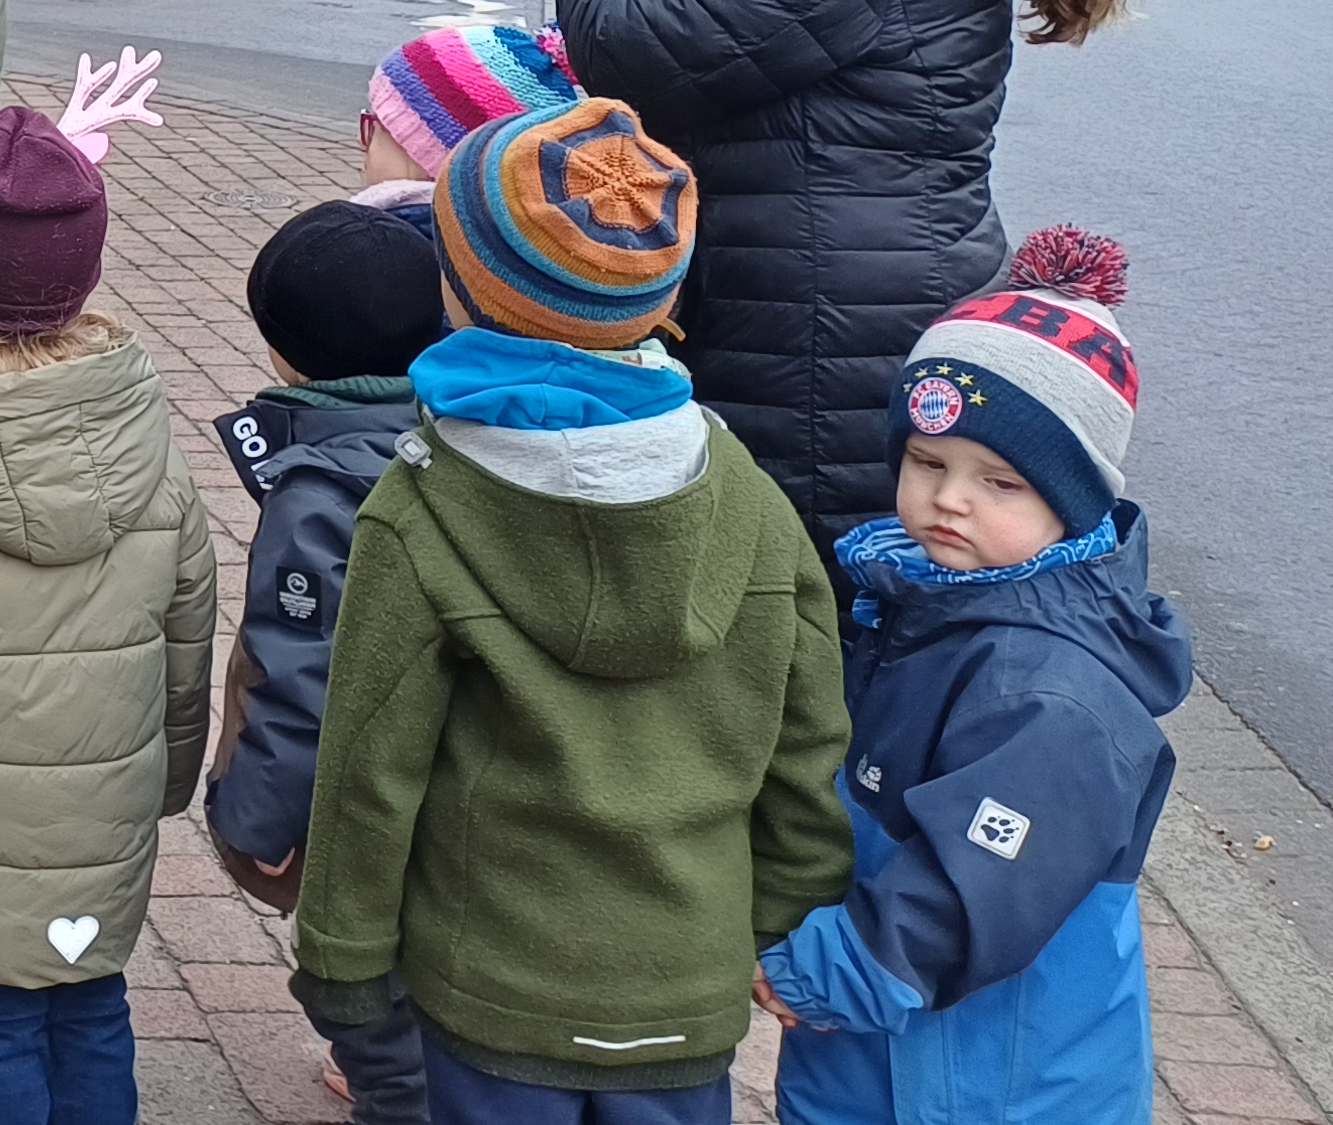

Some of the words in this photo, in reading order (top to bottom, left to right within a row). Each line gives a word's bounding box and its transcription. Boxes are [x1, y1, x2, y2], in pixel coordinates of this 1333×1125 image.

[995, 297, 1131, 392] BA
[925, 379, 959, 406] BAYERN
[233, 416, 268, 458] GO
